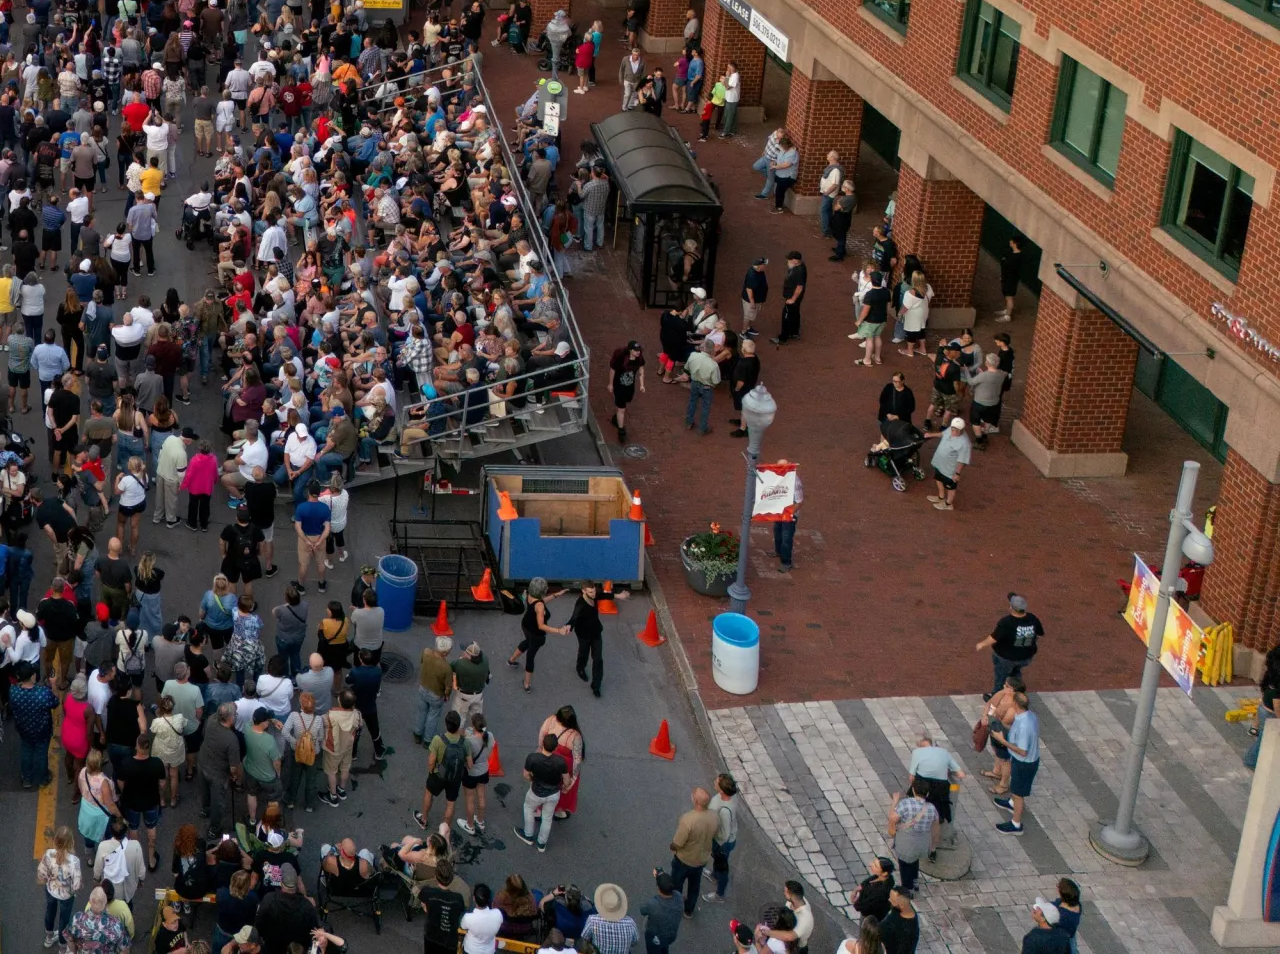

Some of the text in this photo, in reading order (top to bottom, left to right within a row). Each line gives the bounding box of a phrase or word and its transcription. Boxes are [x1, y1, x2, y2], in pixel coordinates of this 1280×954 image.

[731, 0, 750, 22] LEASE
[752, 17, 781, 48] 506.378.0212
[1134, 578, 1147, 622] Downing
[1178, 630, 1193, 676] Downing
[169, 932, 184, 948] SALTY
